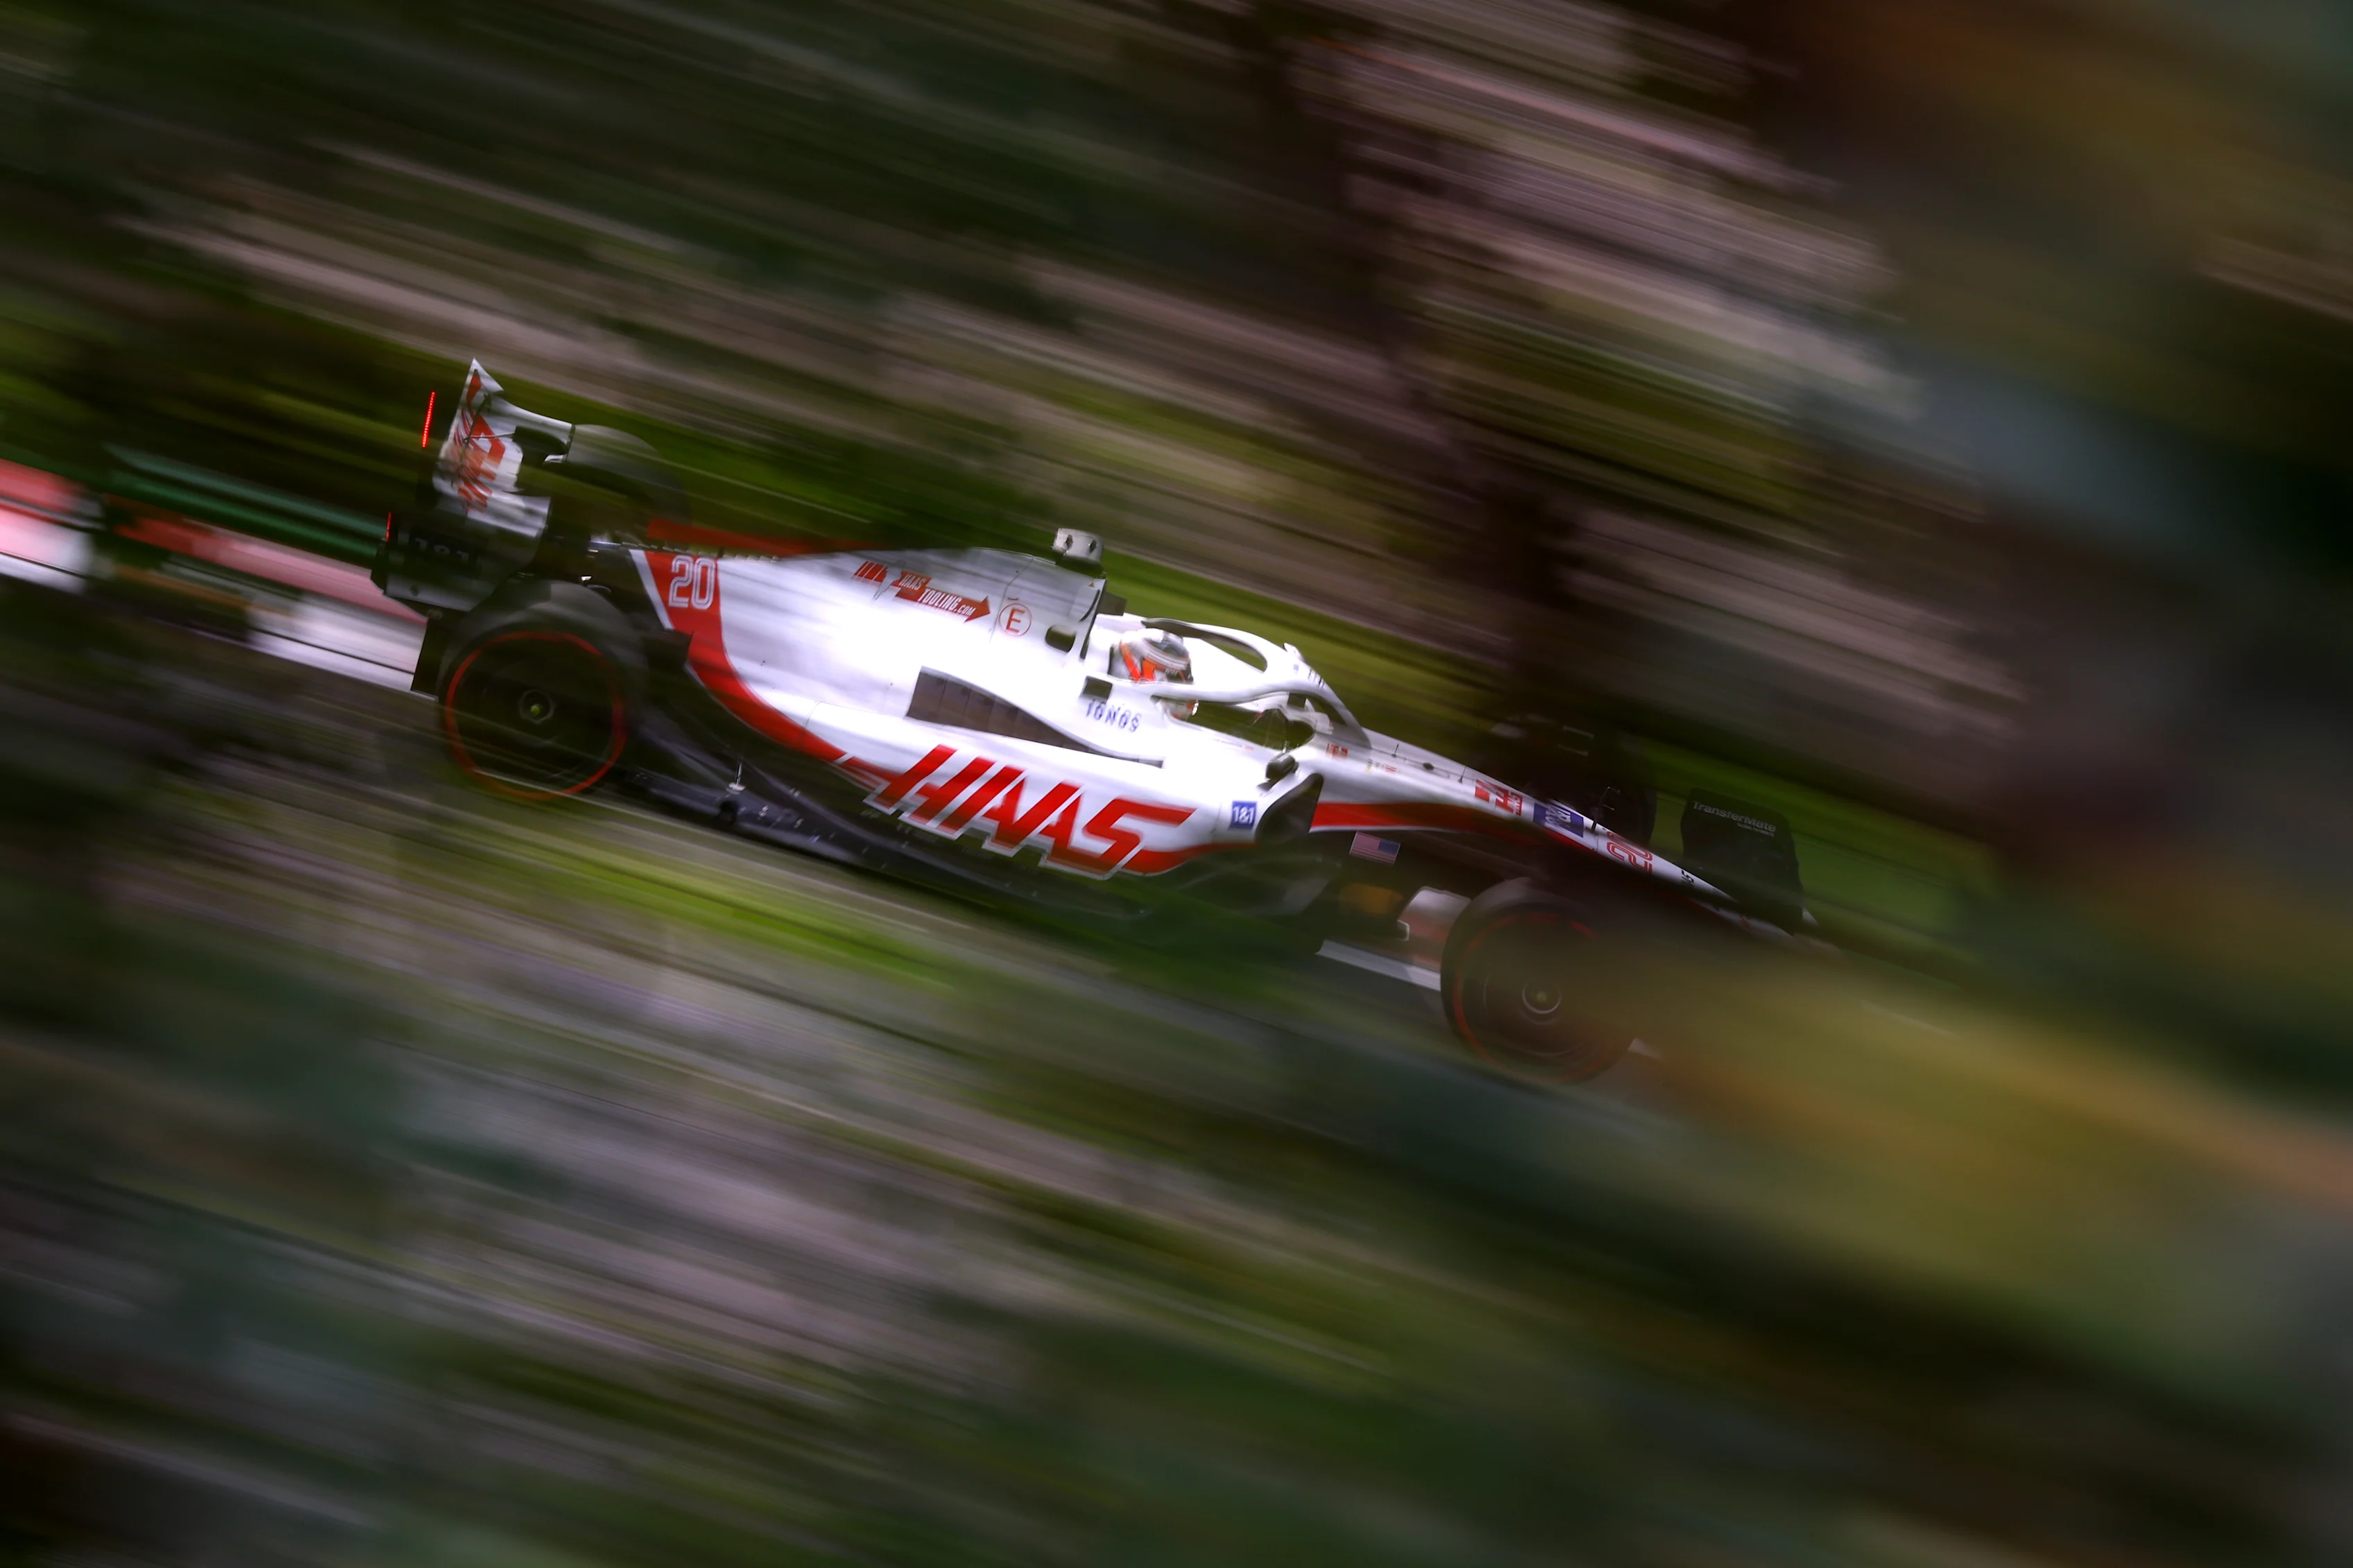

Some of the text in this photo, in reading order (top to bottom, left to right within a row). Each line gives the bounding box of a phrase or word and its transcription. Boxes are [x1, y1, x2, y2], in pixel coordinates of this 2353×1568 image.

[667, 555, 717, 610] 20
[898, 574, 926, 591] HAAS
[1006, 607, 1025, 633] E
[1086, 698, 1143, 733] IONOS
[862, 744, 1197, 880] HAAS
[1233, 805, 1255, 825] 1&1
[1691, 800, 1777, 833] TransferMate
[1606, 830, 1653, 873] 20
